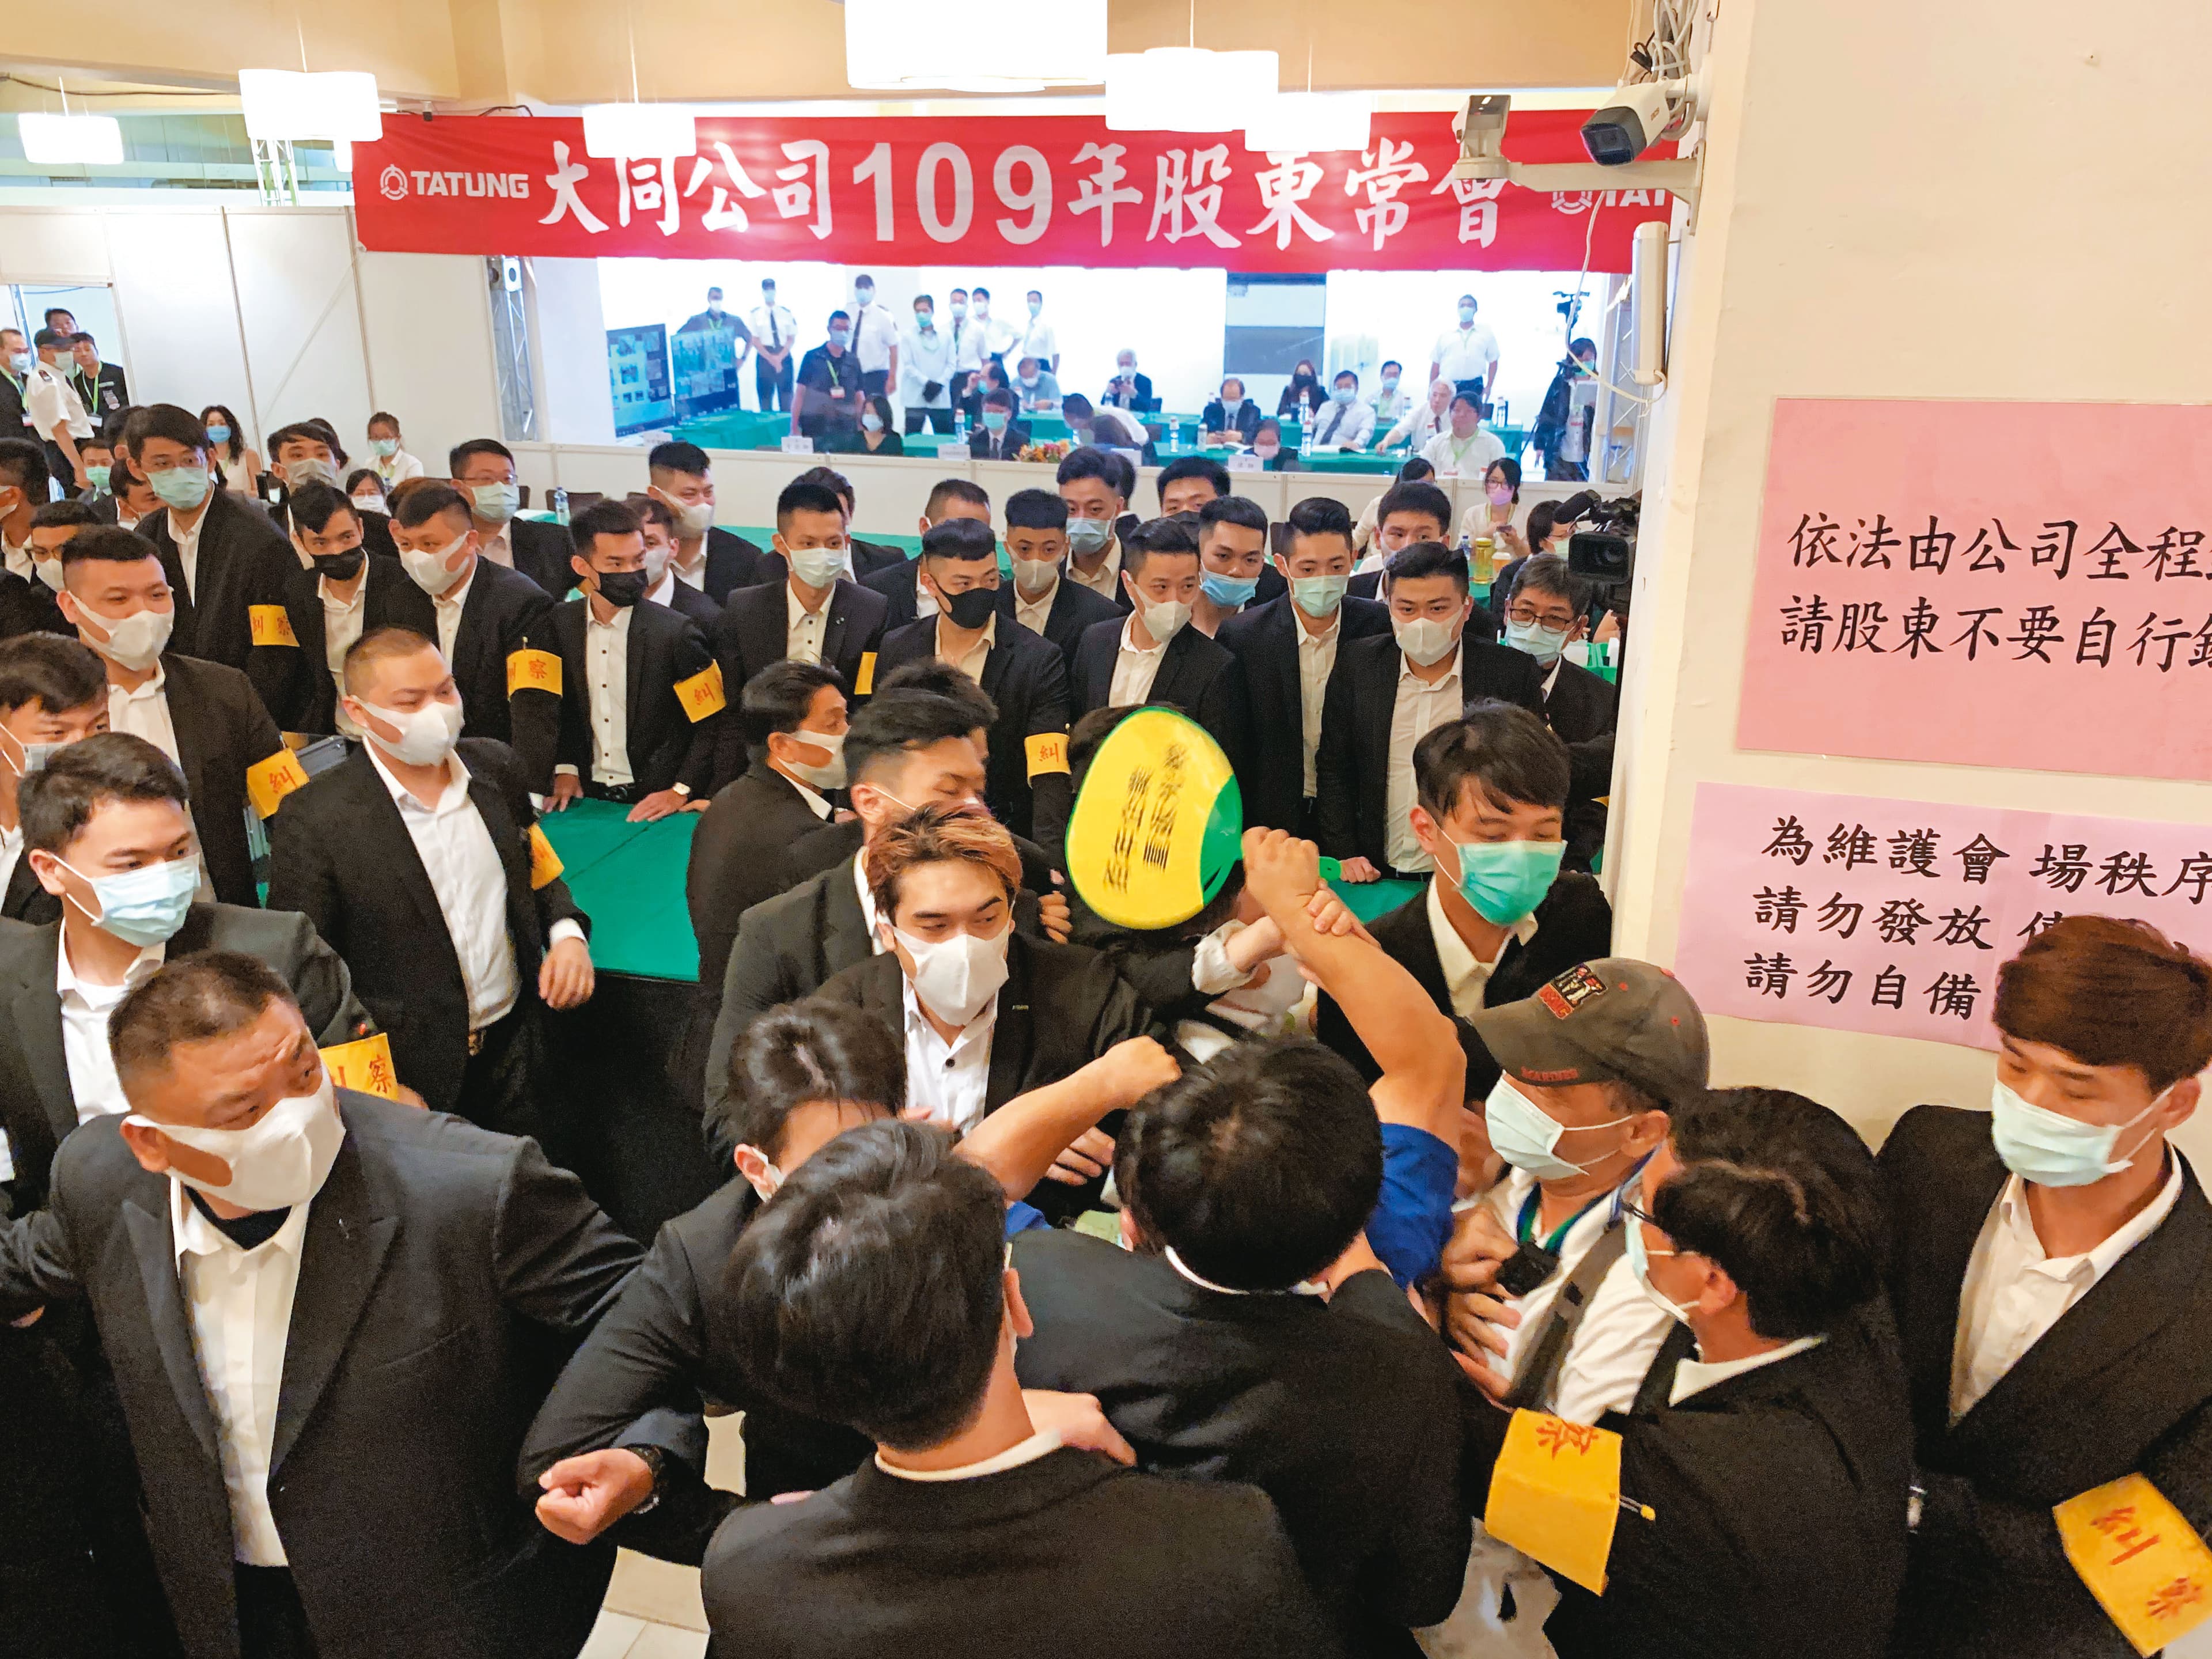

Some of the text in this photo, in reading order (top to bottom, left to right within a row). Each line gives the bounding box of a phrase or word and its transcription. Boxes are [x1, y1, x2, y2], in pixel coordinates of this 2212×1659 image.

[411, 171, 530, 199] TATUNG
[539, 137, 1521, 251] 大同公司109年股東常會
[1787, 512, 2212, 582] 依法由公司全程
[1744, 952, 1982, 1020] 請勿自備
